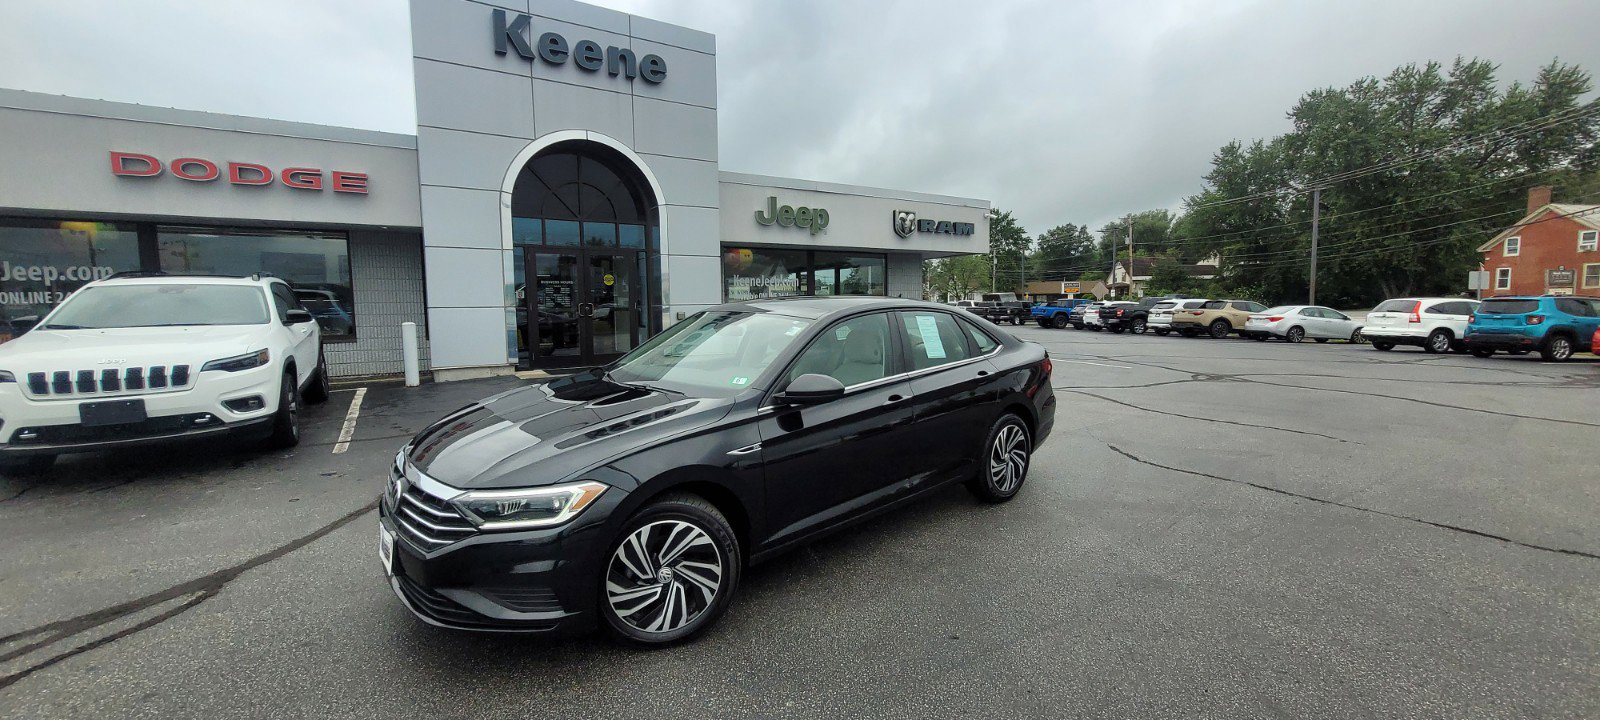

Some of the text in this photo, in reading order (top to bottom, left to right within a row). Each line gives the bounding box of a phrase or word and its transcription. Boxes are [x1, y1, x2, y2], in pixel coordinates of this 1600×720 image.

[492, 8, 667, 84] Keene
[108, 150, 370, 194] DODGE
[754, 196, 830, 236] Jeep
[917, 218, 975, 236] RAM
[0, 291, 52, 305] ONLINE
